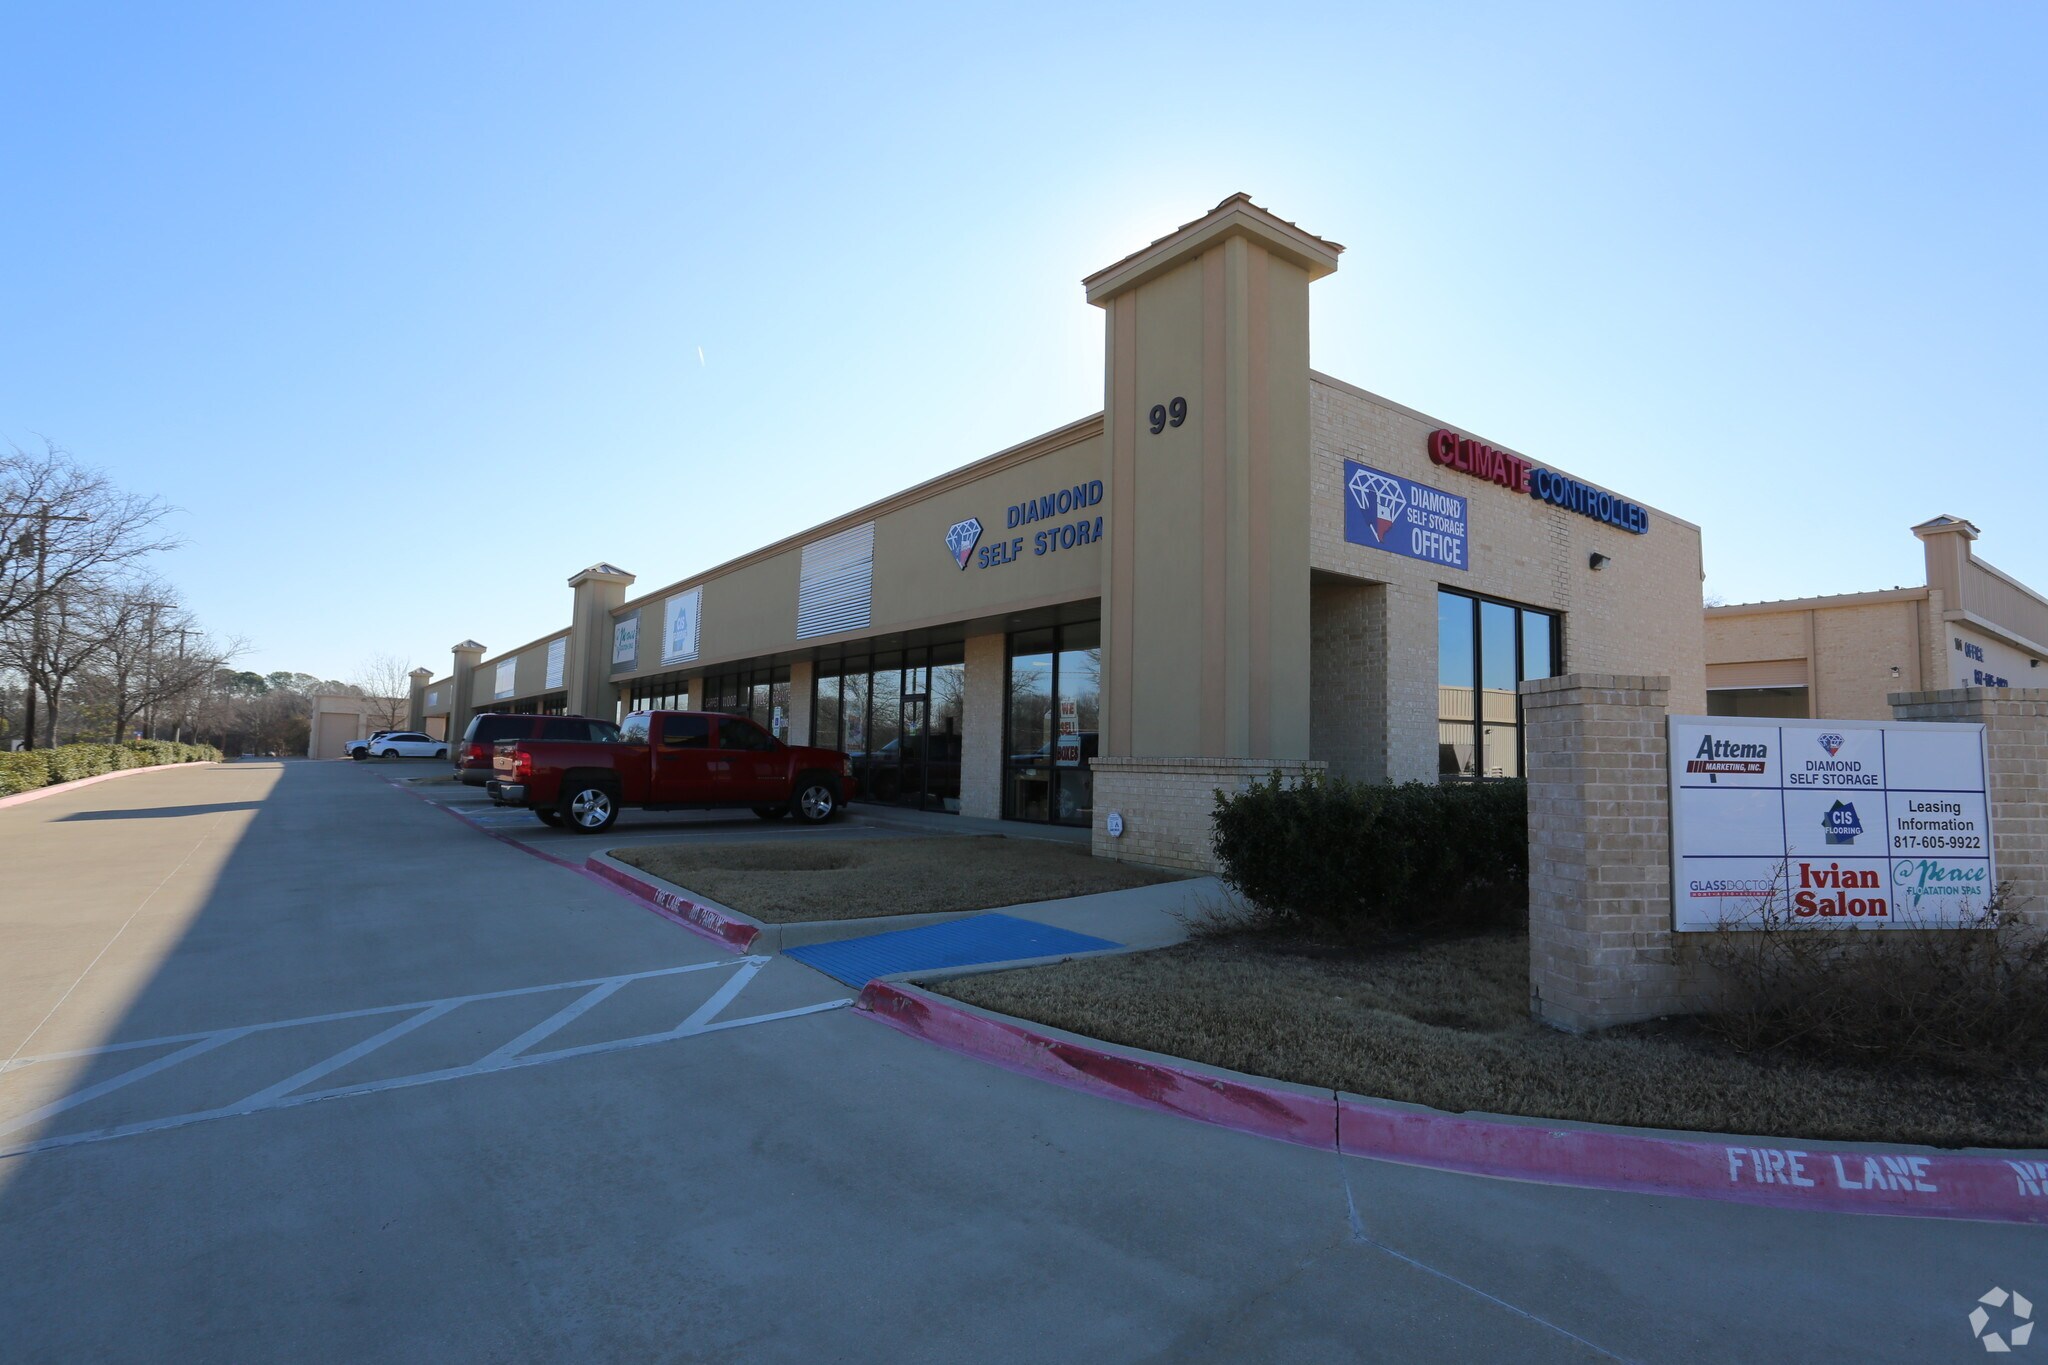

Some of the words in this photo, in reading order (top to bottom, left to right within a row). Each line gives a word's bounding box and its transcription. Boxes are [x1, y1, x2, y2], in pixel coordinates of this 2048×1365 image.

[1149, 396, 1188, 435] 99
[1428, 429, 1532, 494] CLIMATE
[1529, 467, 1649, 535] CONTROLLED
[1007, 479, 1104, 529] DIAMOND
[1410, 486, 1461, 519] DIAMOND
[1407, 507, 1428, 525] SELF
[1429, 513, 1465, 538] STORAGE
[978, 536, 1024, 570] SELF
[1412, 528, 1462, 565] OFFICE
[1062, 702, 1075, 715] WE
[1056, 745, 1079, 761] BOXES
[1705, 762, 1747, 773] MARKETING,
[1747, 763, 1762, 772] INC.
[1806, 760, 1862, 773] DIAMOND
[1790, 773, 1820, 785] SELF
[1822, 773, 1879, 786] STORAGE
[1909, 799, 1961, 816] Leasing
[1832, 811, 1853, 825] CIS
[1898, 817, 1975, 832] Information
[1825, 827, 1861, 835] FLOORING
[1893, 835, 1981, 850] 817-605-9922
[1799, 862, 1880, 889] Ivian
[1907, 886, 1959, 895] FLOATATION
[1961, 886, 1981, 895] SPAS
[1794, 891, 1888, 917] Salon
[1725, 1147, 1815, 1187] FIRE
[1833, 1154, 1938, 1193] LANE
